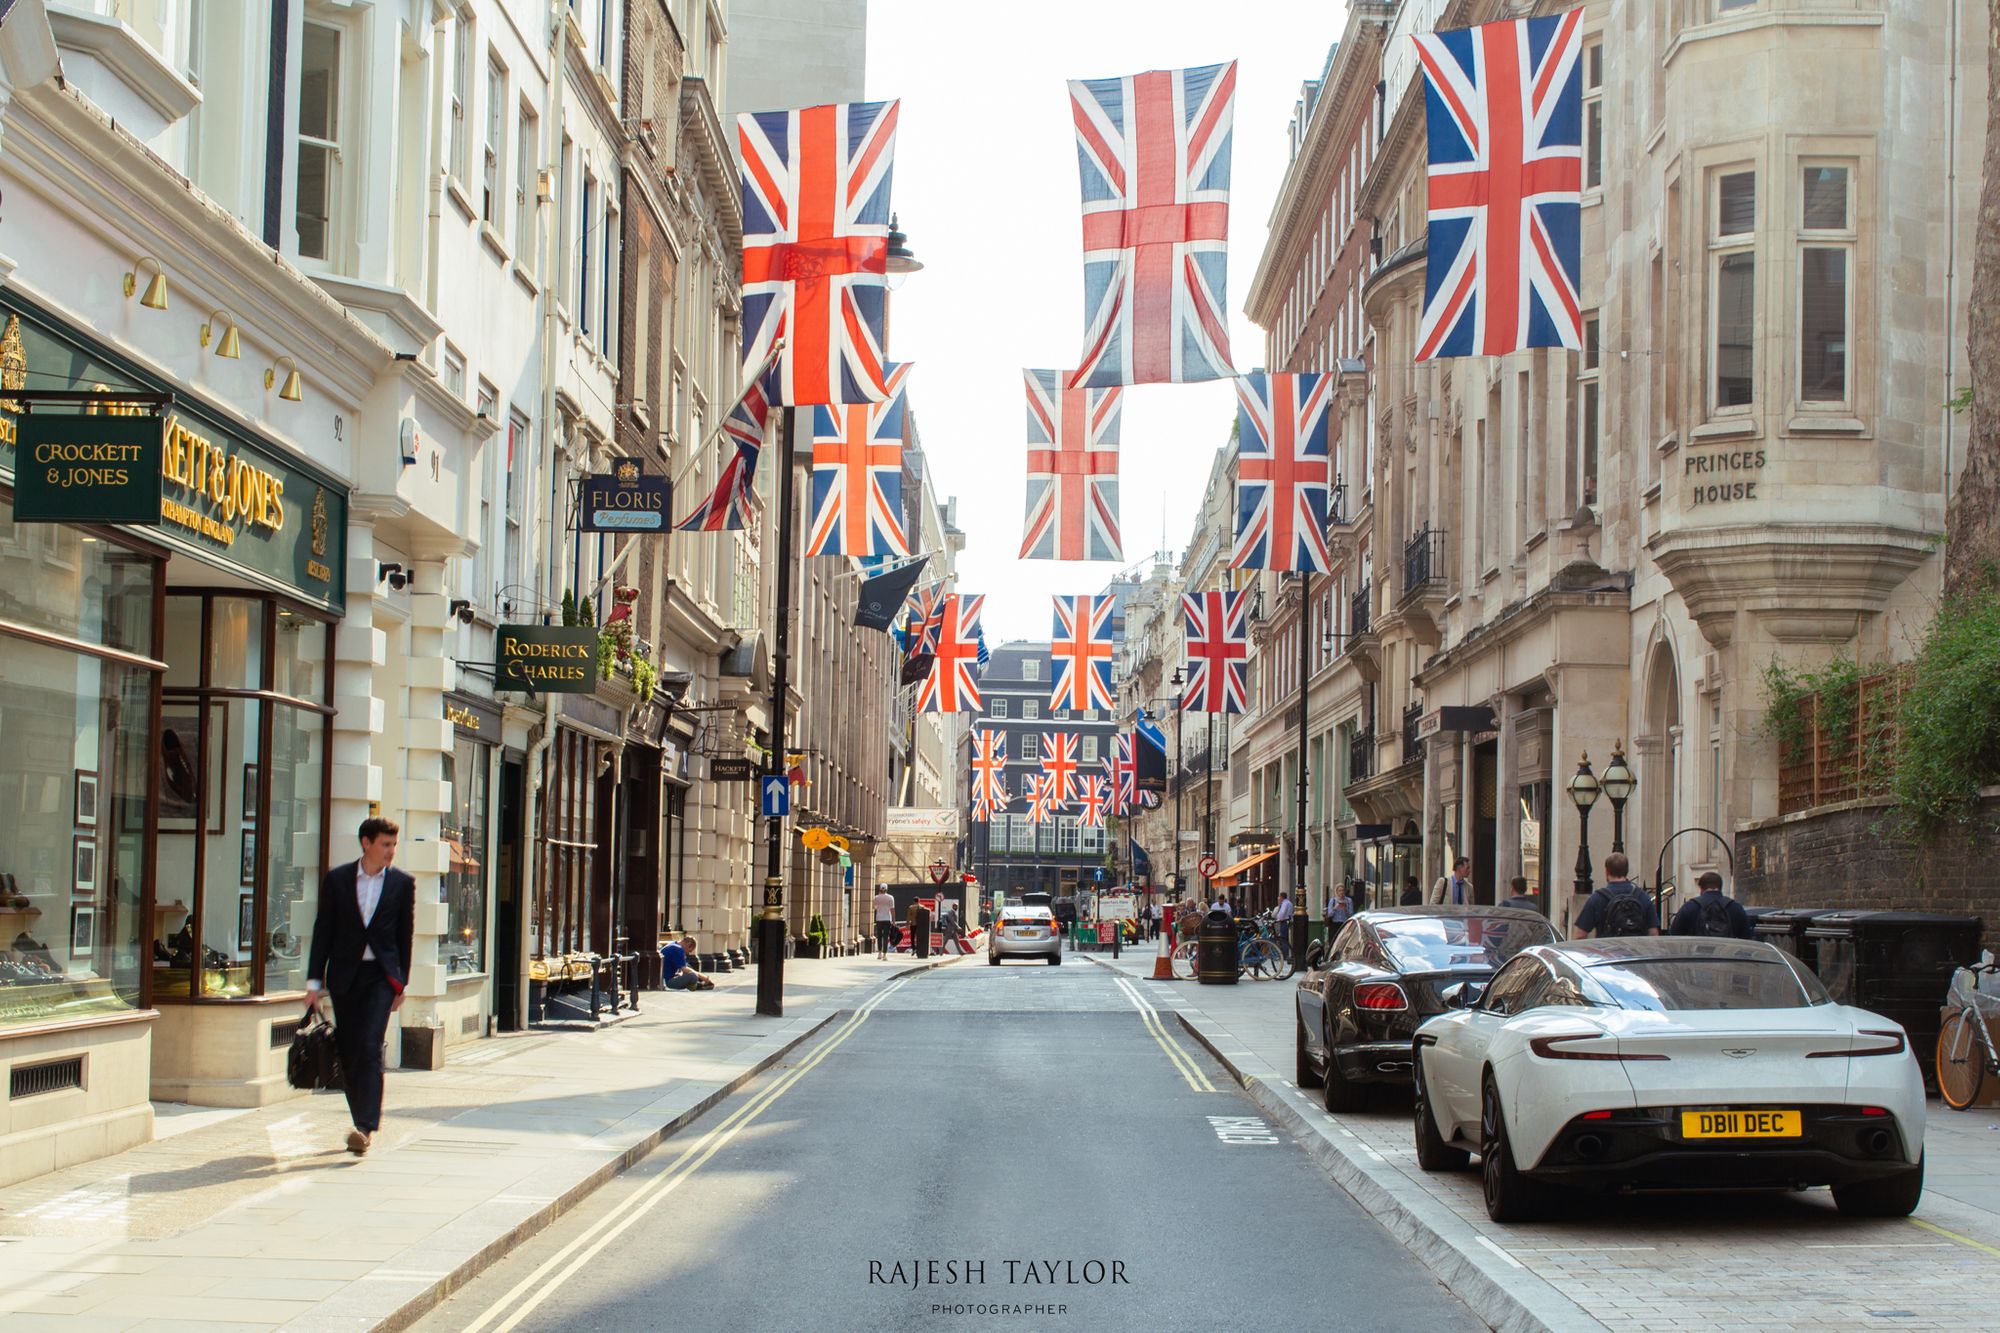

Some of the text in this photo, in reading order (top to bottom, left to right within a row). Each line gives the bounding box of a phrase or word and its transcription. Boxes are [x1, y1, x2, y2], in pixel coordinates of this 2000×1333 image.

[334, 414, 343, 442] 92
[34, 442, 142, 464] CROCKETT
[1685, 450, 1766, 475] PRINCES
[431, 449, 439, 483] 91
[46, 467, 130, 488] & JONES
[210, 446, 227, 504] &
[222, 454, 284, 532] JONES
[592, 490, 662, 509] FLORIS
[1693, 482, 1758, 505] HOUSE
[598, 511, 658, 526] Perfumes
[201, 516, 235, 545] ENGLAND
[504, 637, 590, 658] RODERICK
[507, 659, 585, 680] CHARLES
[911, 818, 931, 826] safety
[1744, 1113, 1785, 1133] DEC
